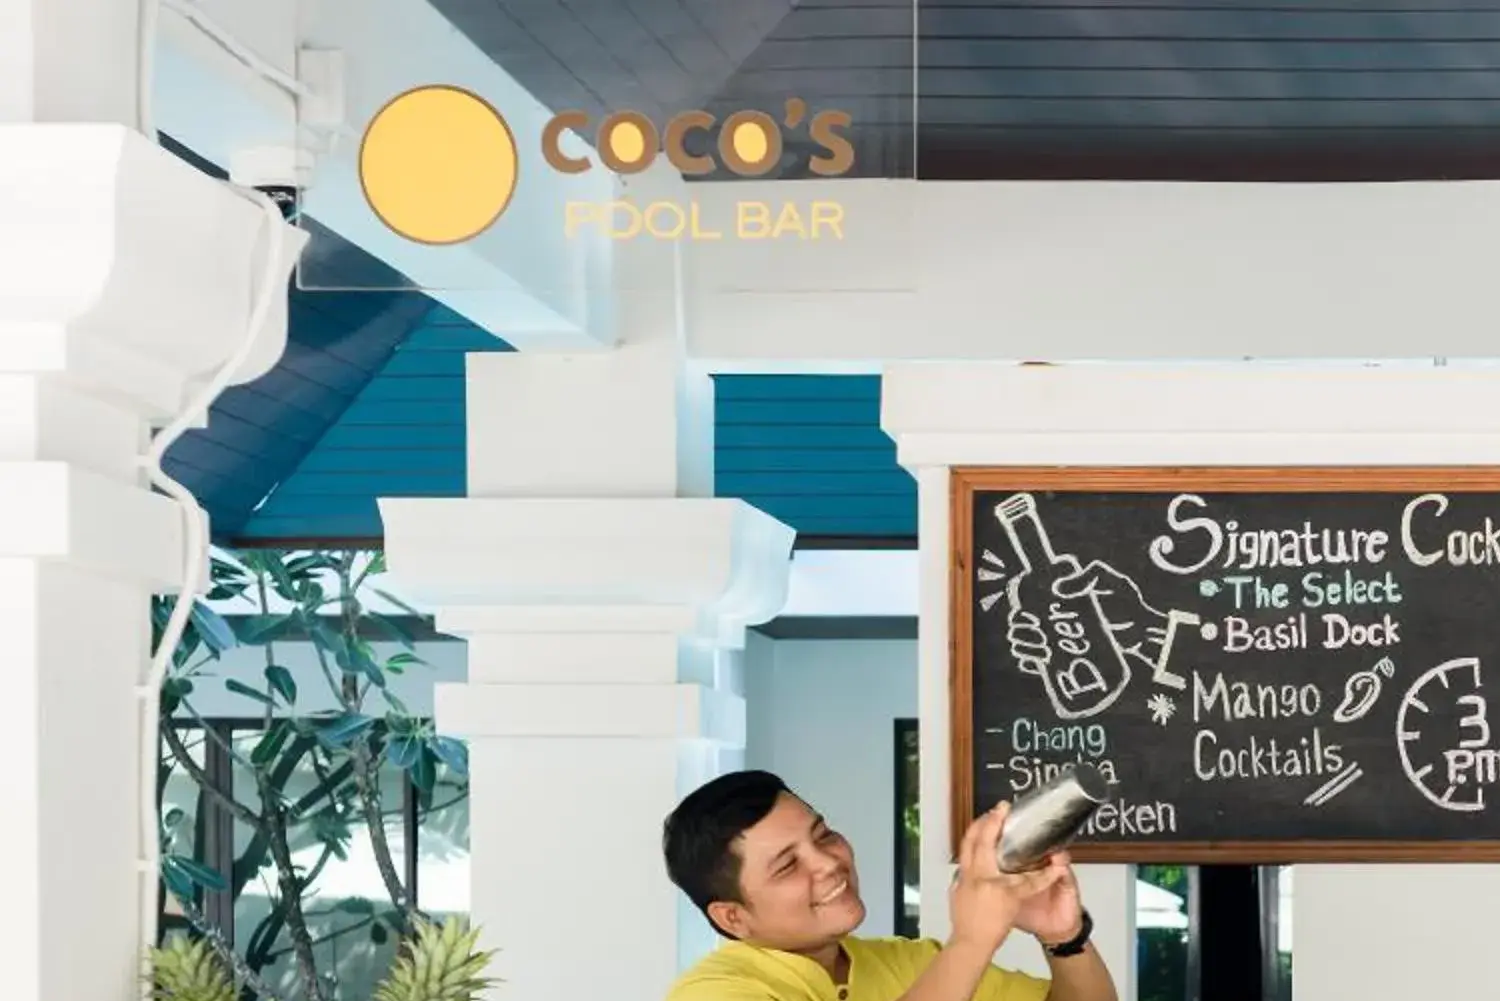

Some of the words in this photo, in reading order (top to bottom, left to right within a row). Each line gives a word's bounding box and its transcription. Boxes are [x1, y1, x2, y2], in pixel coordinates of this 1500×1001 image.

[541, 97, 855, 175] COCO'S
[564, 200, 722, 240] POOL
[735, 200, 846, 240] BAR
[1149, 493, 1389, 574] Signature
[1223, 574, 1290, 609] The
[1302, 571, 1402, 607] Select
[1048, 602, 1108, 700] Beer
[1223, 613, 1308, 653] Basil
[1322, 613, 1401, 650] Dock
[1192, 670, 1322, 723] Mango
[1455, 694, 1490, 749] 3
[1011, 717, 1107, 757] Chang
[1193, 727, 1345, 782] Cocktails
[1009, 755, 1120, 792] Sina
